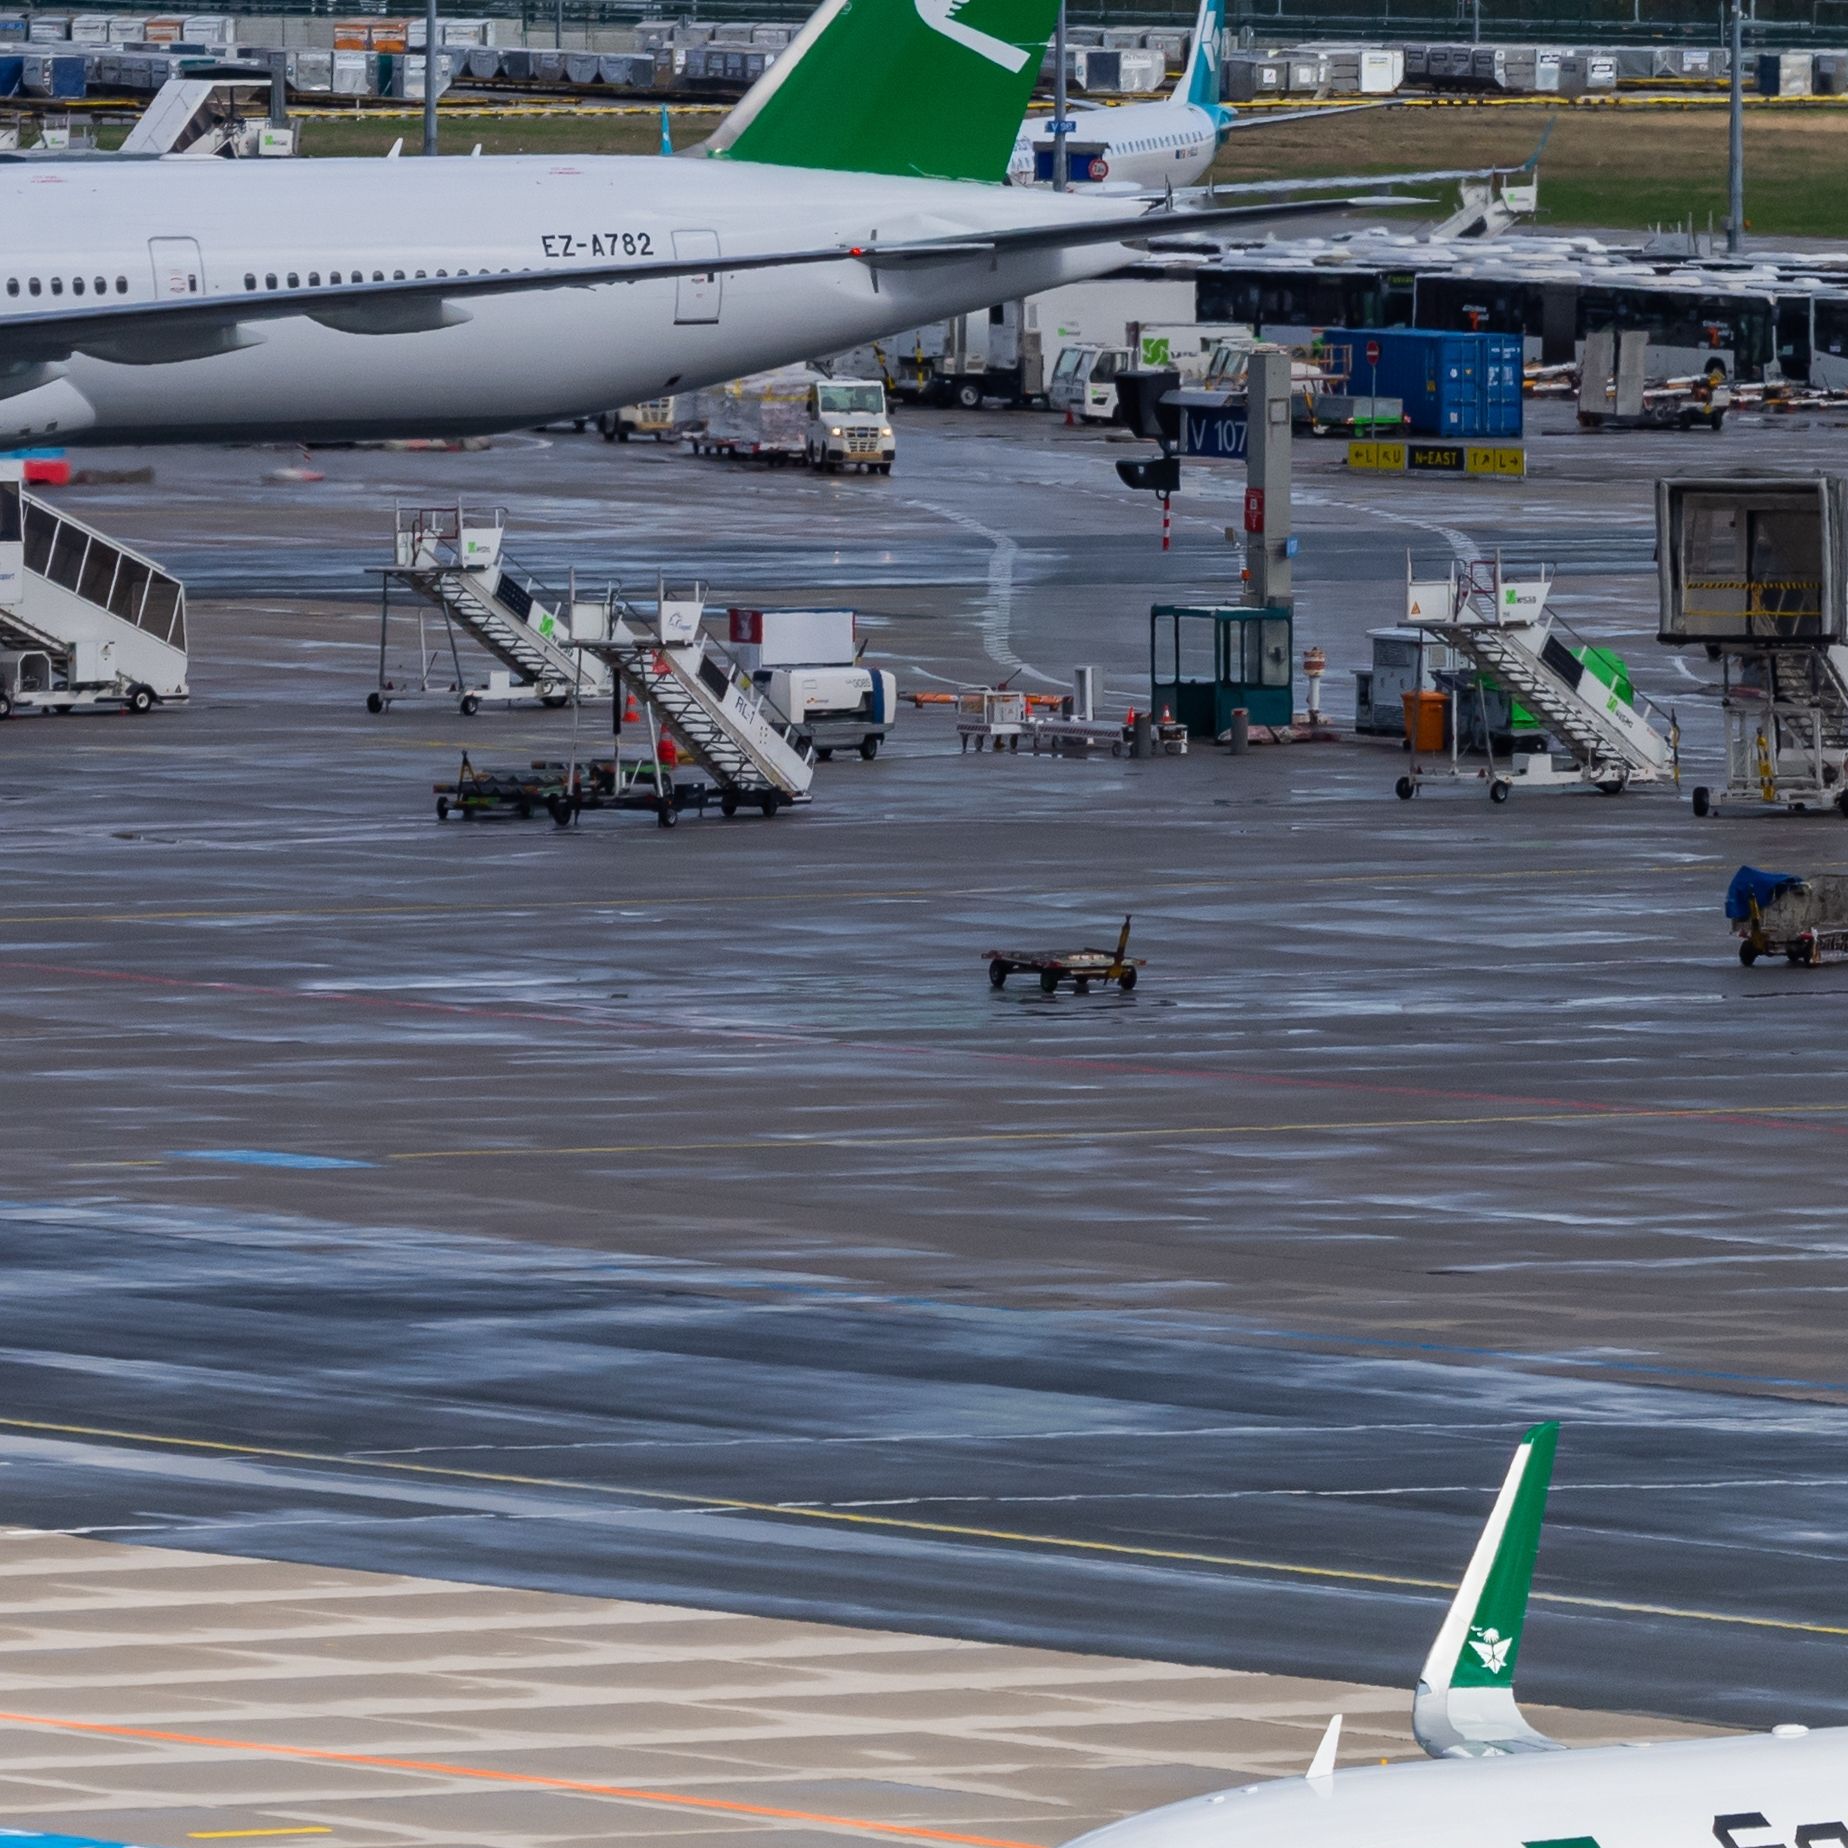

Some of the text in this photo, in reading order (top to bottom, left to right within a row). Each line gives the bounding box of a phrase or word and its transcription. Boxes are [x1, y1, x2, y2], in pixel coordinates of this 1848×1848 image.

[541, 232, 654, 257] EZ-A782
[1191, 418, 1248, 452] V 107
